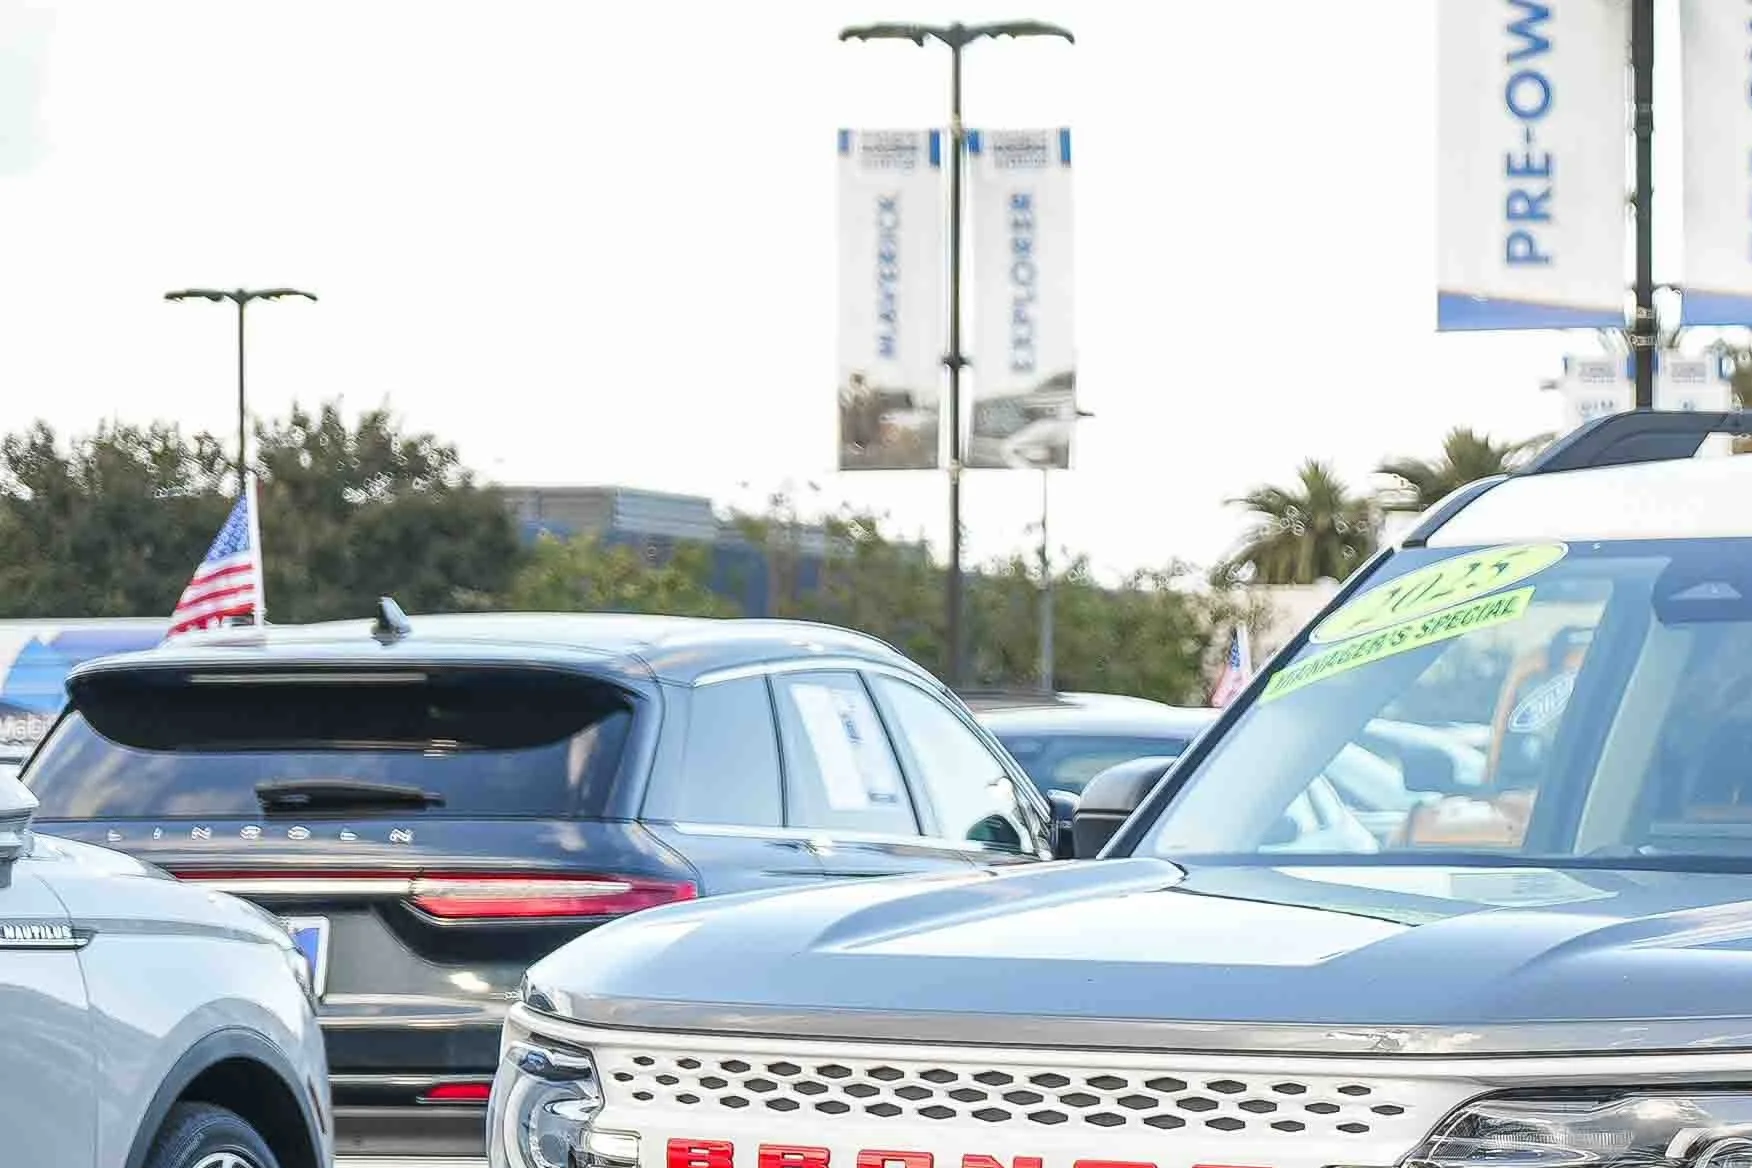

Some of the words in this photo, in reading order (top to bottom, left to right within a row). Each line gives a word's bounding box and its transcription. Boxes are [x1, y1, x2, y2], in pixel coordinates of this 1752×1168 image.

[878, 193, 899, 357] MAVERICK
[1010, 193, 1036, 371] EXPLORER
[1414, 598, 1517, 640] SPECIAL
[3, 924, 72, 940] NAUTILUS
